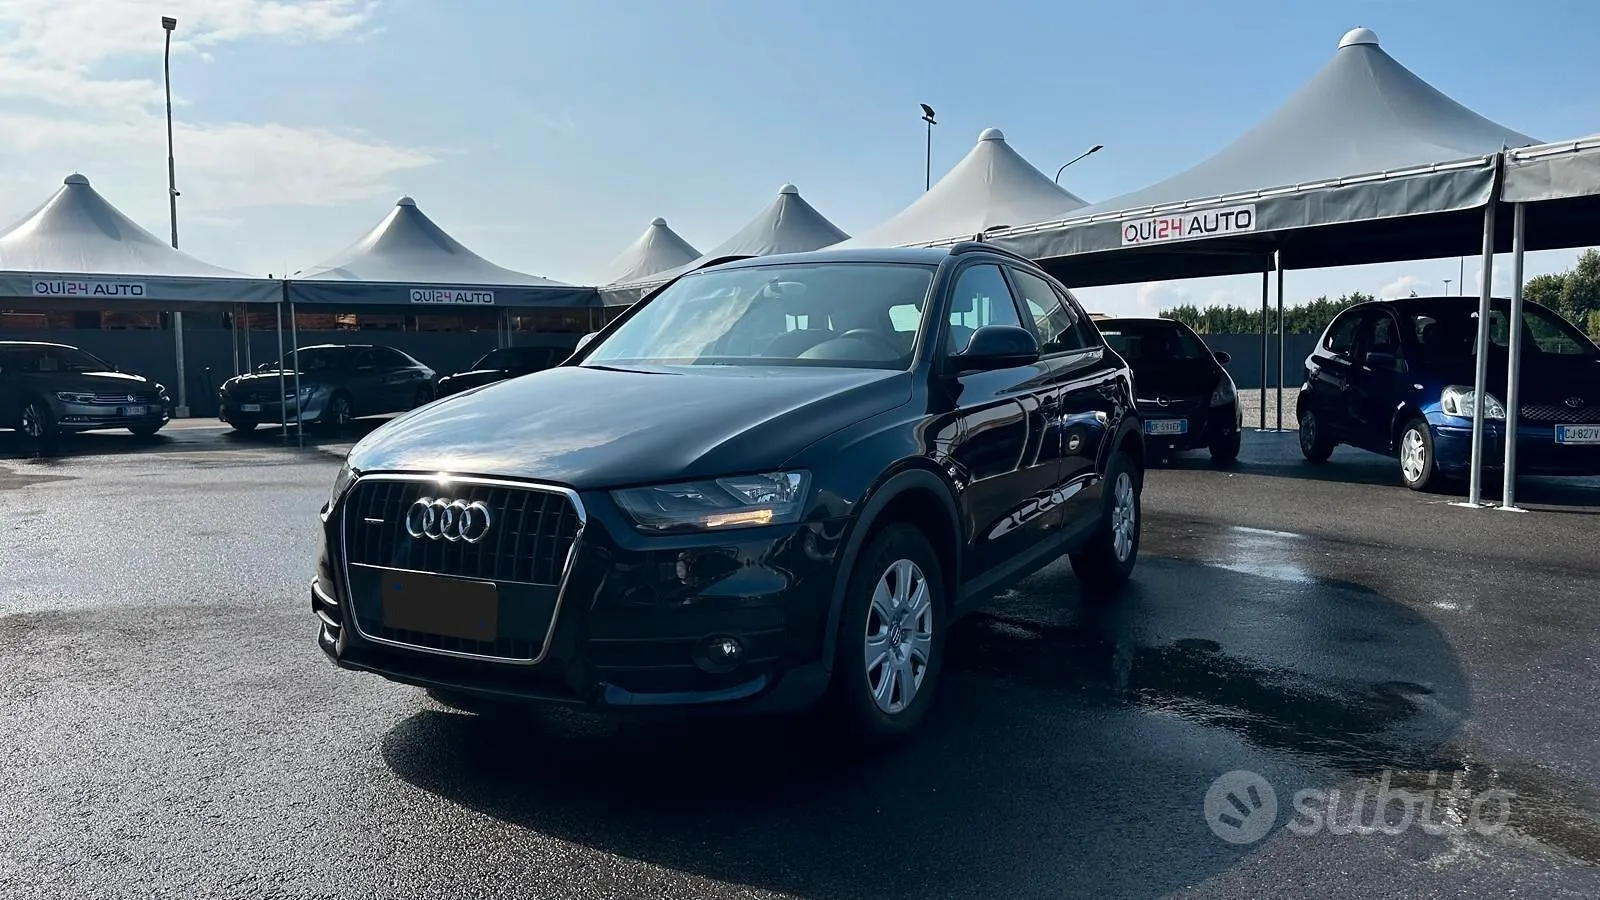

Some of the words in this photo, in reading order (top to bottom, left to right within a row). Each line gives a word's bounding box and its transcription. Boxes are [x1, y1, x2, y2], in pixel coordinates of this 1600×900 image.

[1188, 210, 1252, 234] AUTO
[93, 284, 143, 295] AUTO
[455, 292, 492, 303] AUTO
